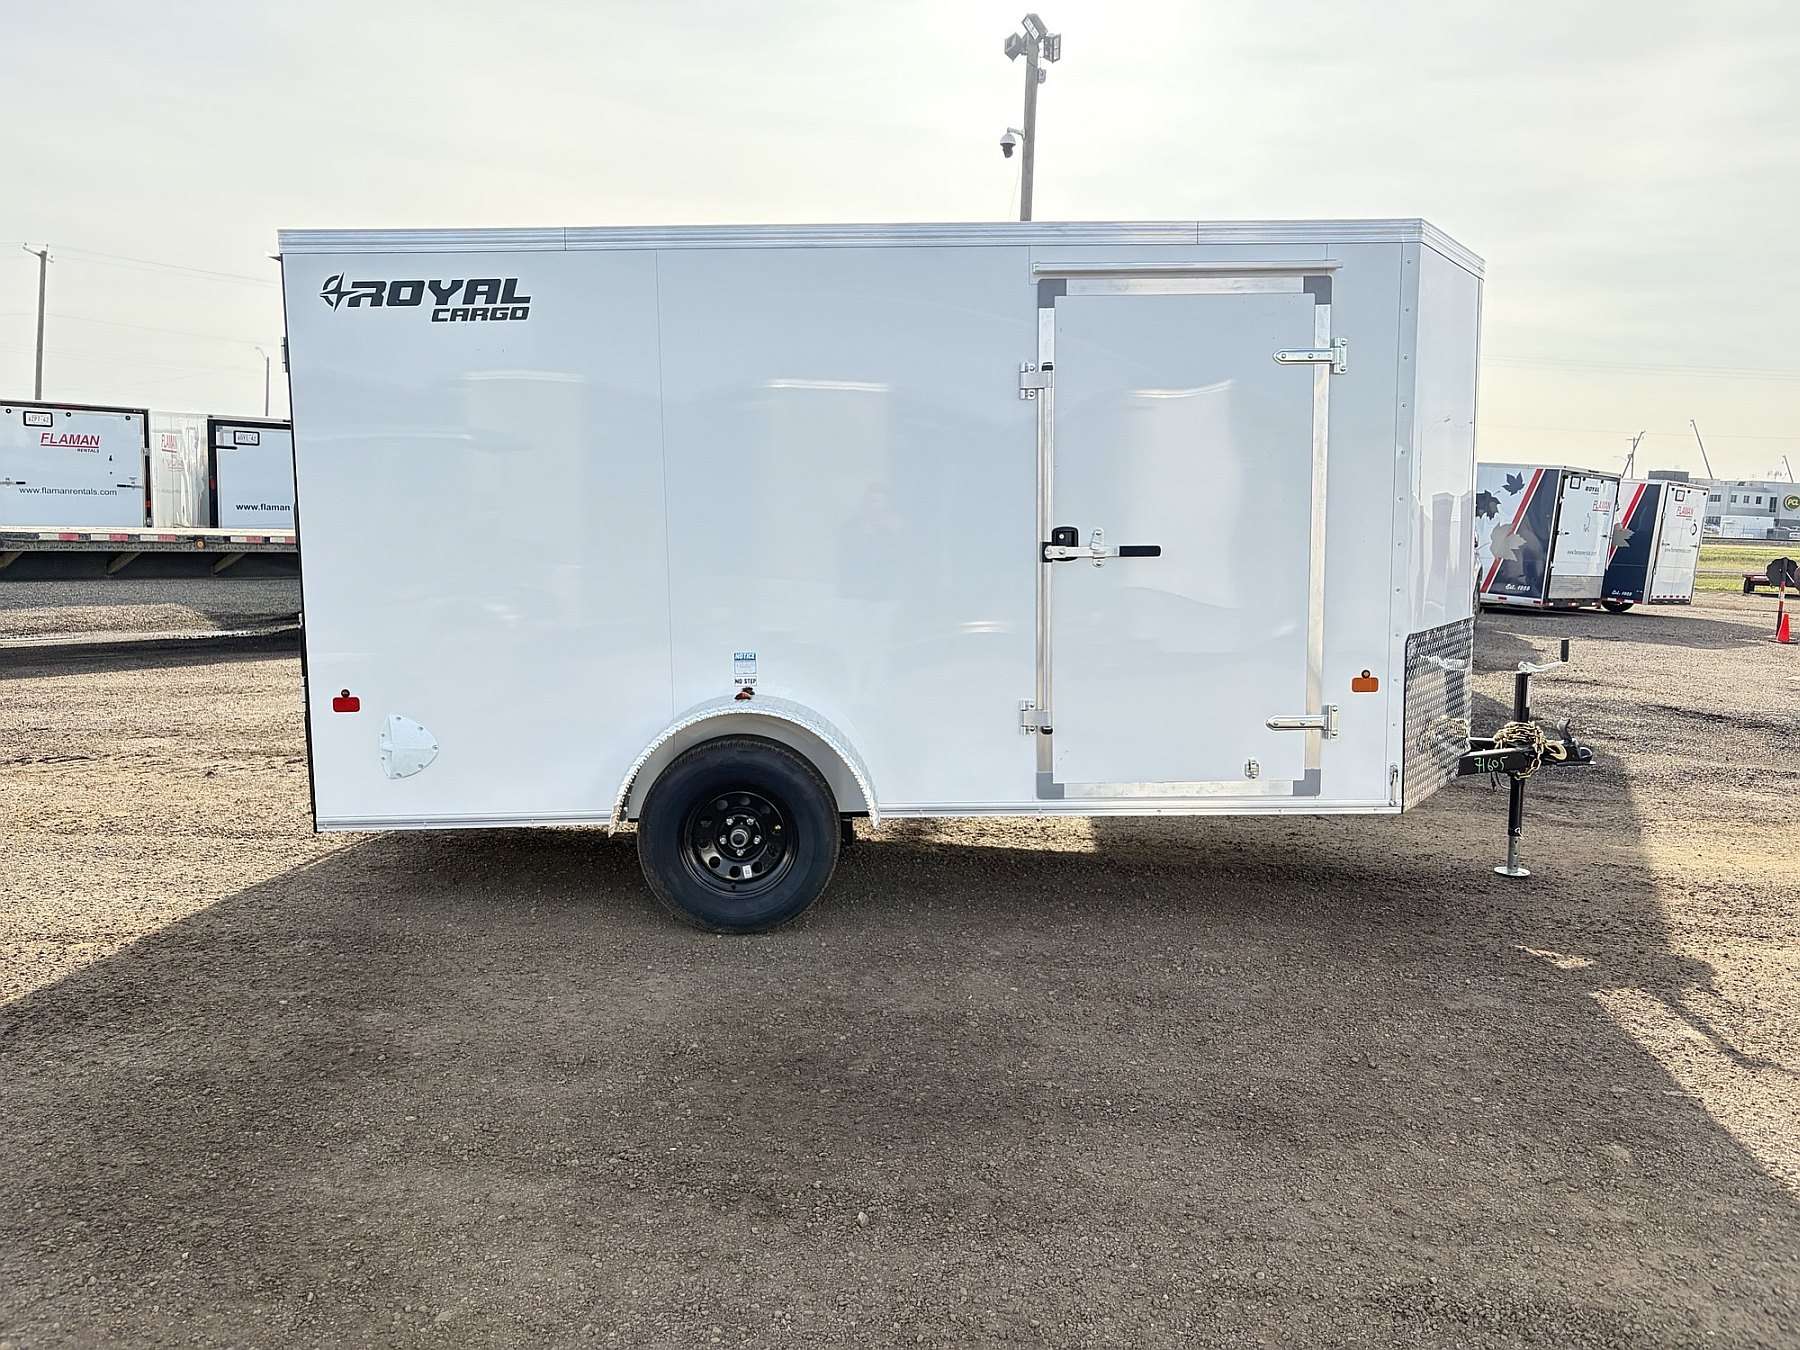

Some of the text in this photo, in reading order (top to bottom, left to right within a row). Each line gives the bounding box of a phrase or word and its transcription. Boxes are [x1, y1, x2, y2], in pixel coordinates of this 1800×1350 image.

[347, 278, 532, 307] ROYAL
[431, 306, 530, 322] CARGO
[40, 432, 100, 446] FLAMAN
[19, 487, 117, 496] www.flamanrentals.com
[1474, 756, 1508, 773] 71605
